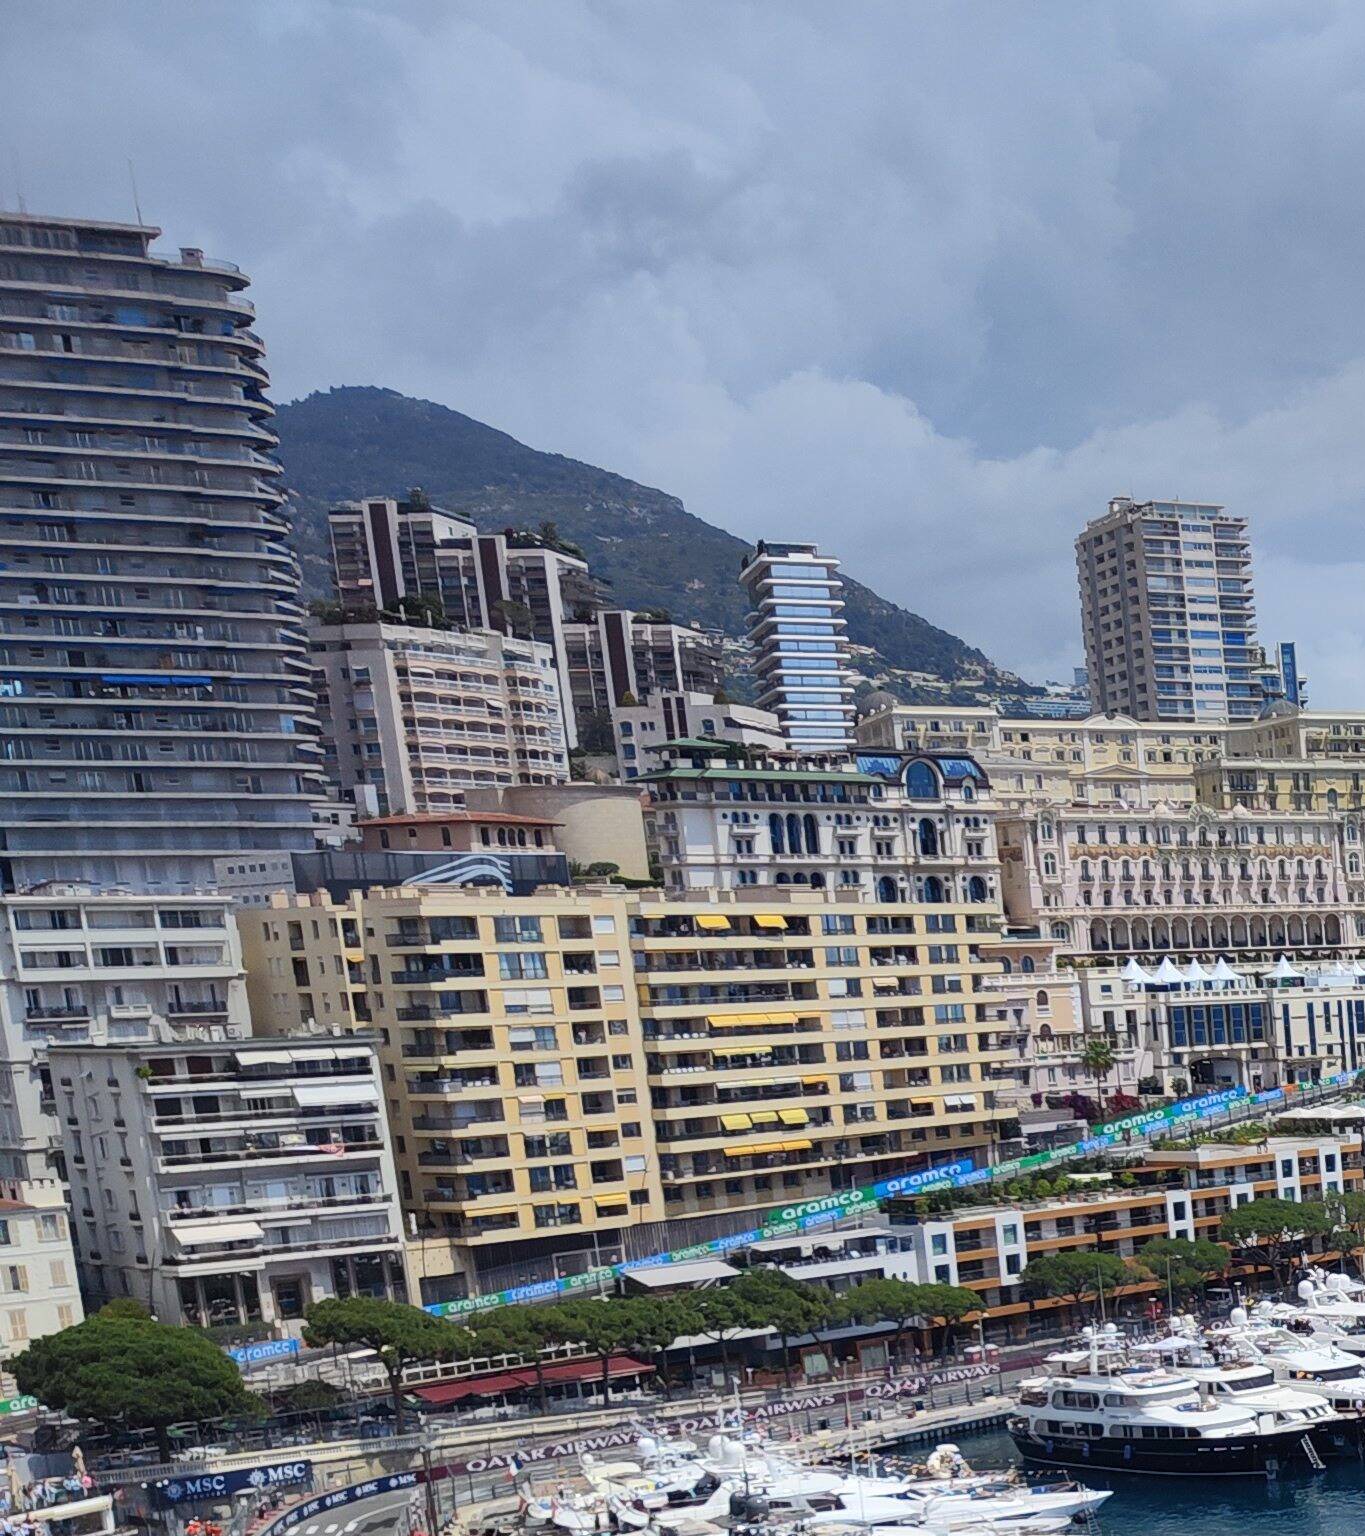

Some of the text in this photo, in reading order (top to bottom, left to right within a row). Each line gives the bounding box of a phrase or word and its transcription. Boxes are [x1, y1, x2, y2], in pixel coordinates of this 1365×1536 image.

[1182, 1089, 1238, 1113] aramco
[1103, 1111, 1165, 1134] aramco
[887, 1164, 962, 1191] aramco
[781, 1190, 864, 1219] aramco
[448, 1294, 499, 1314] aramco
[931, 1364, 1000, 1386] AIRWAYS
[755, 1394, 836, 1419] AIRWAYS
[466, 1431, 643, 1473] QATAR AIRWAYS
[267, 1463, 306, 1482] MSC
[185, 1476, 226, 1495] MSC
